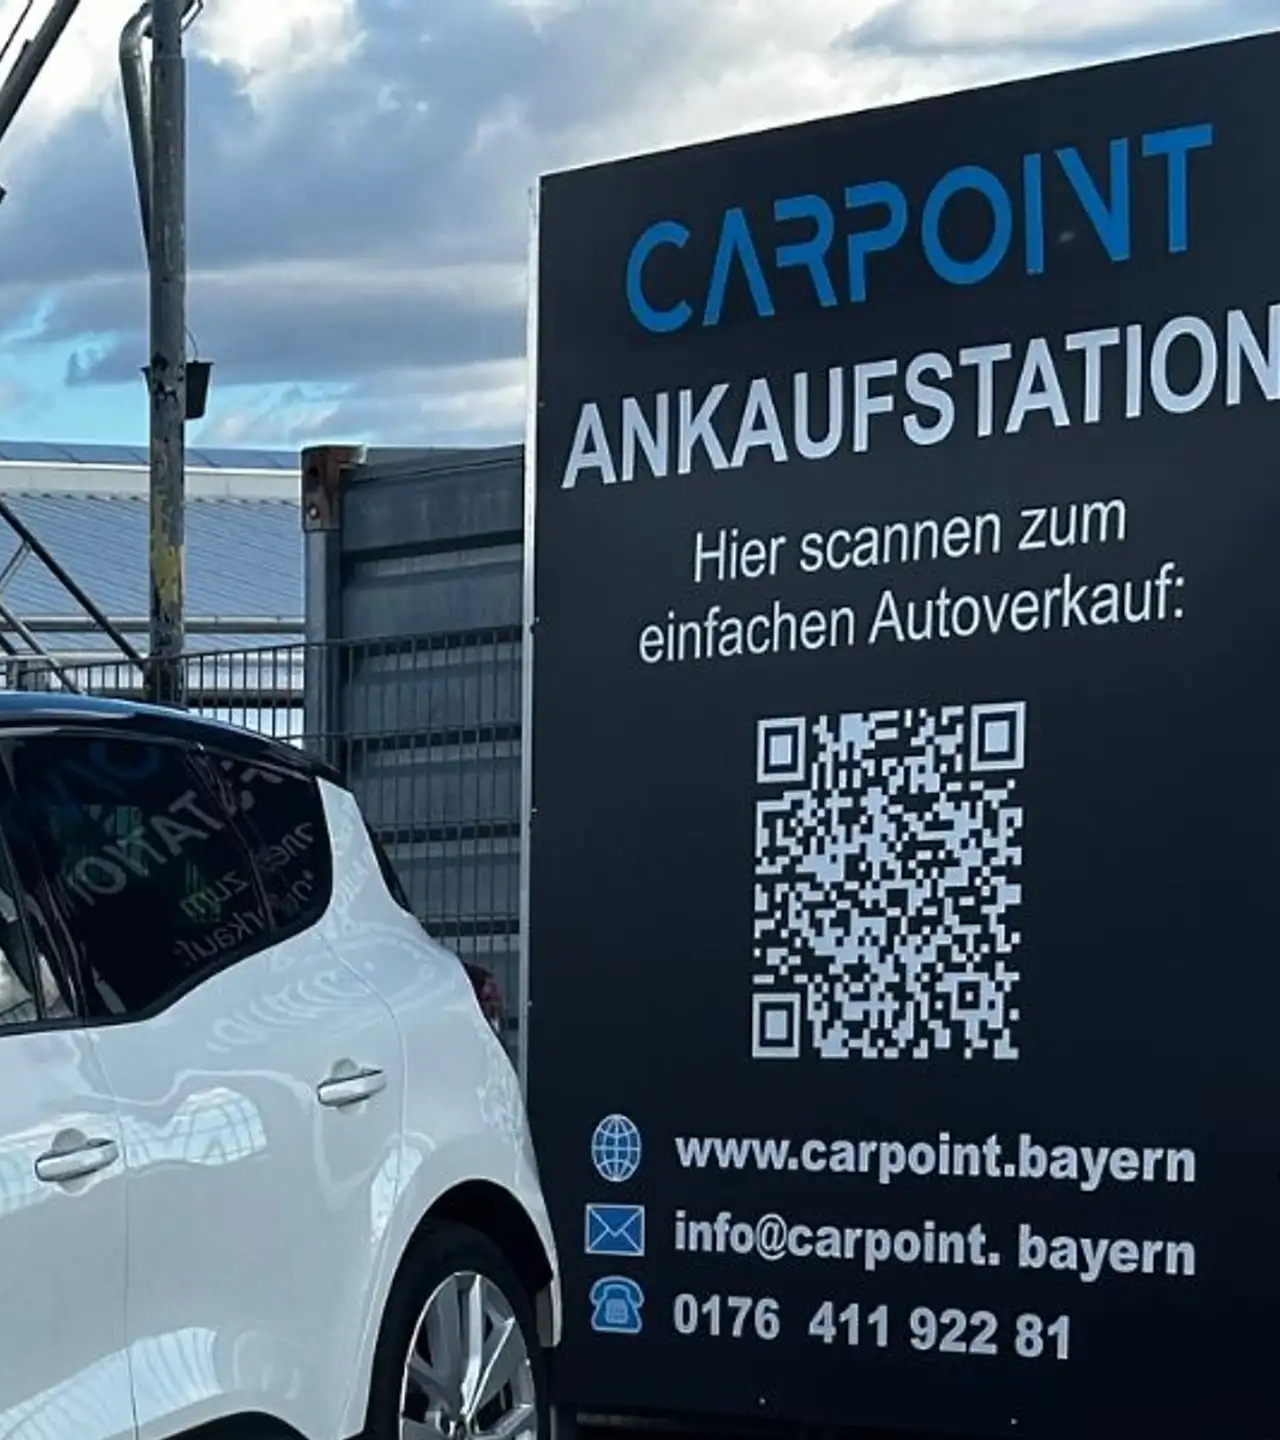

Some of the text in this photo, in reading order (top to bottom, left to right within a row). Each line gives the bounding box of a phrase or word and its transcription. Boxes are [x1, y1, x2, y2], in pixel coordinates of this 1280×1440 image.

[626, 123, 1214, 333] CARPOINT
[561, 304, 1280, 490] ANKAUFSTATION
[693, 498, 1127, 582] Hier scannen zum
[639, 561, 1186, 664] einfachen Autoverkauf:
[675, 1132, 1196, 1191] www.carpoint.bayern
[674, 1210, 1196, 1282] info@carpoint. bayern
[673, 1293, 1071, 1360] 0176 411 922 81
